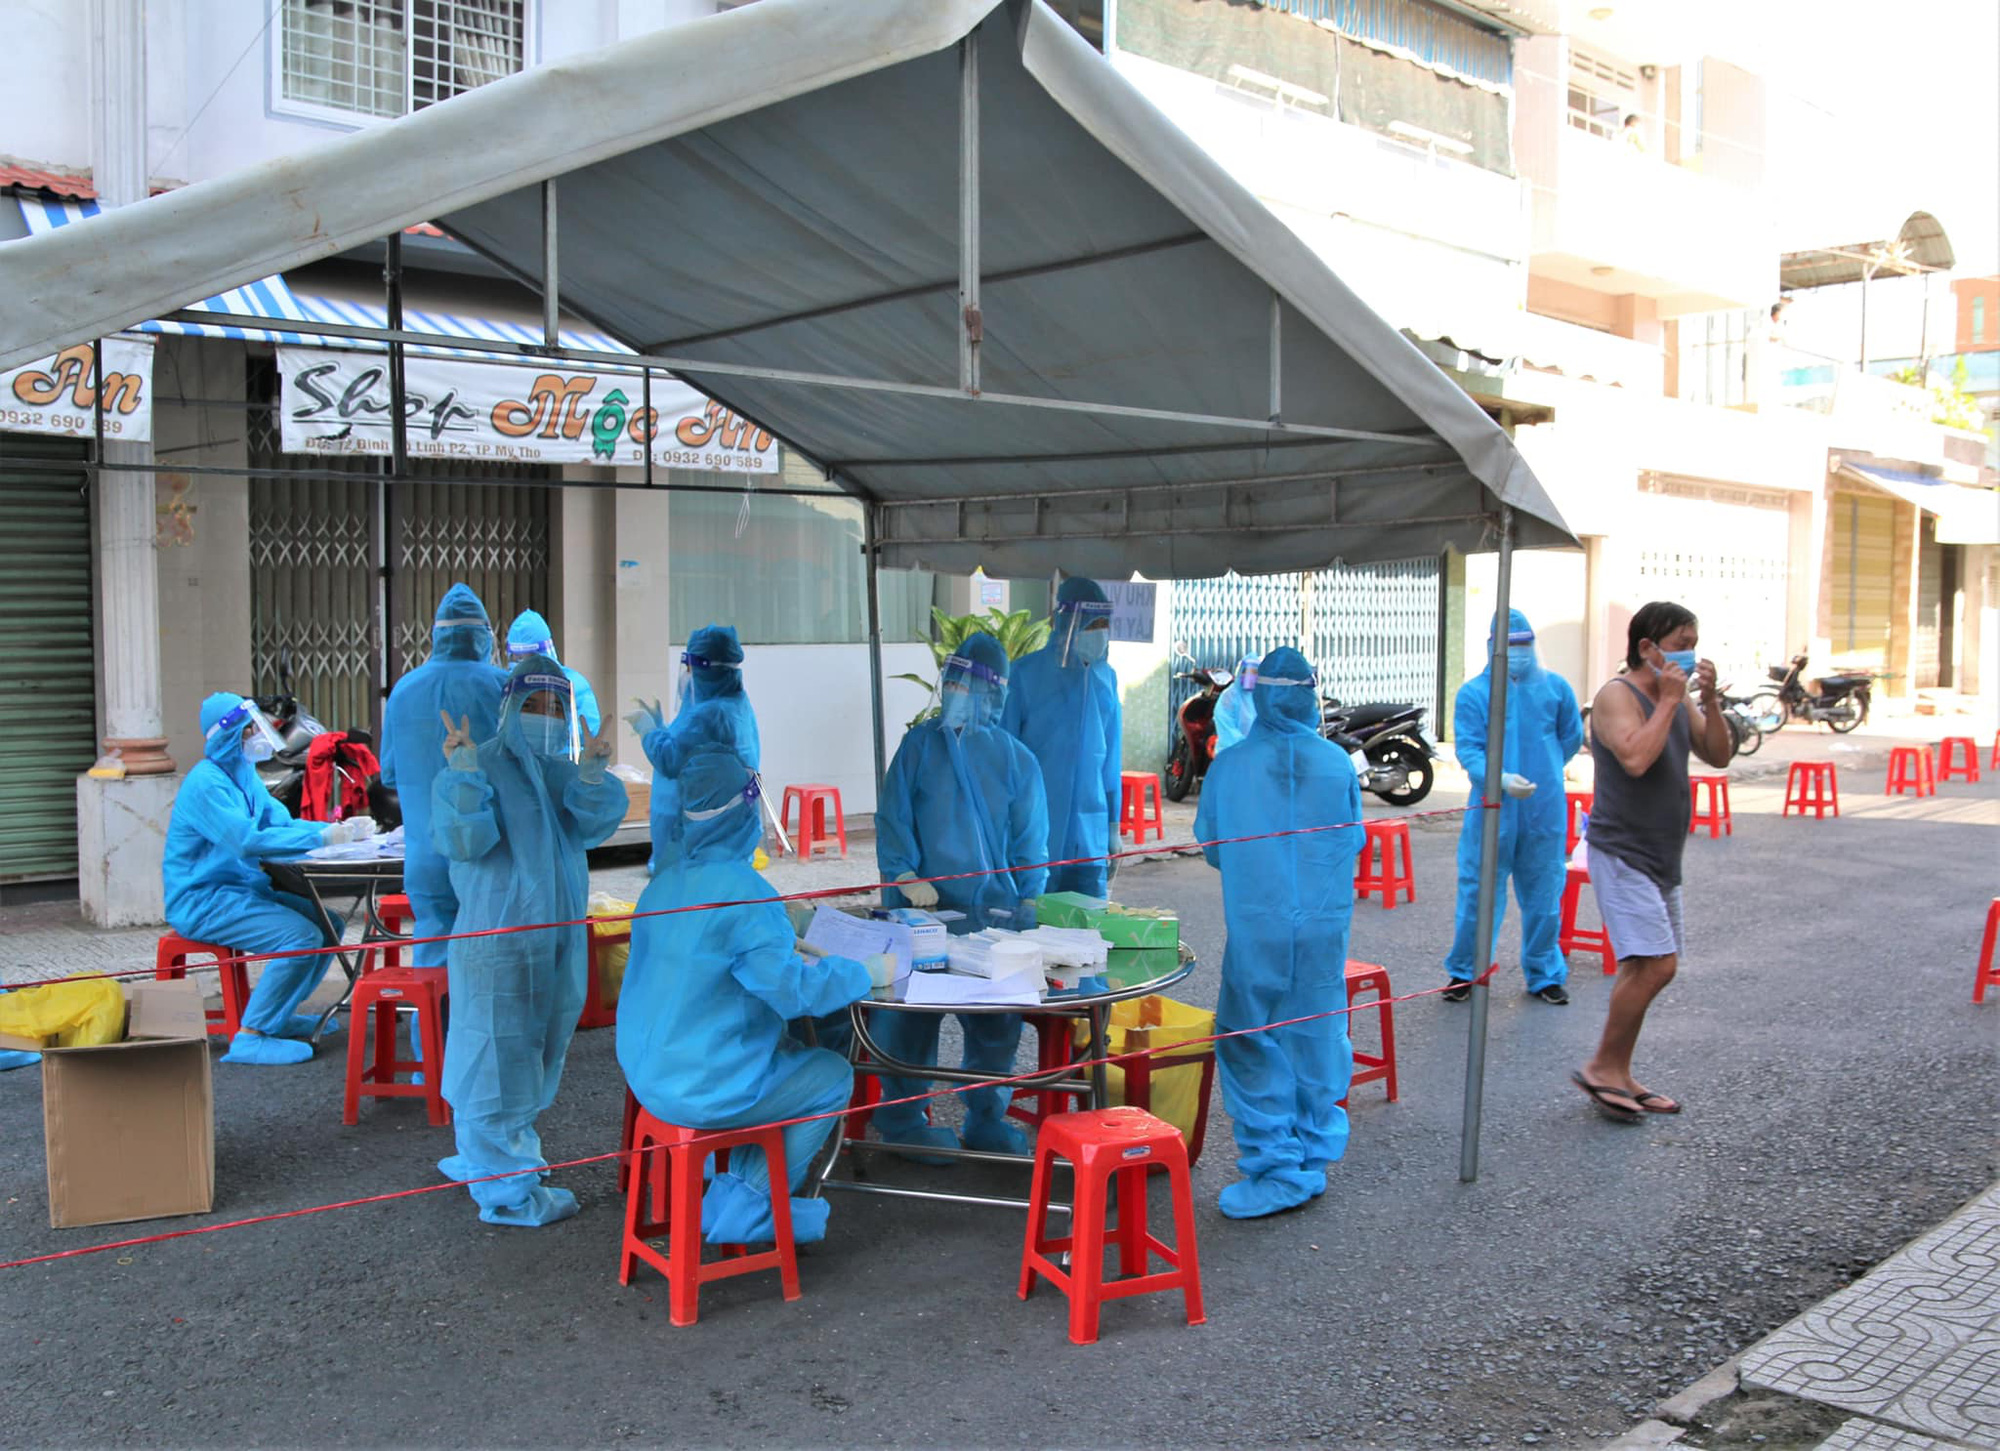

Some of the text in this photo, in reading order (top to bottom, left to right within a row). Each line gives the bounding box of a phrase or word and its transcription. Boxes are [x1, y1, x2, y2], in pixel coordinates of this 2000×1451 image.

[12, 343, 143, 415] An
[292, 361, 774, 461] Shop Mộc An
[51, 414, 85, 429] 690
[518, 445, 541, 458] Tho
[663, 450, 700, 464] 0932
[705, 453, 731, 466] 690
[736, 455, 763, 469] 589
